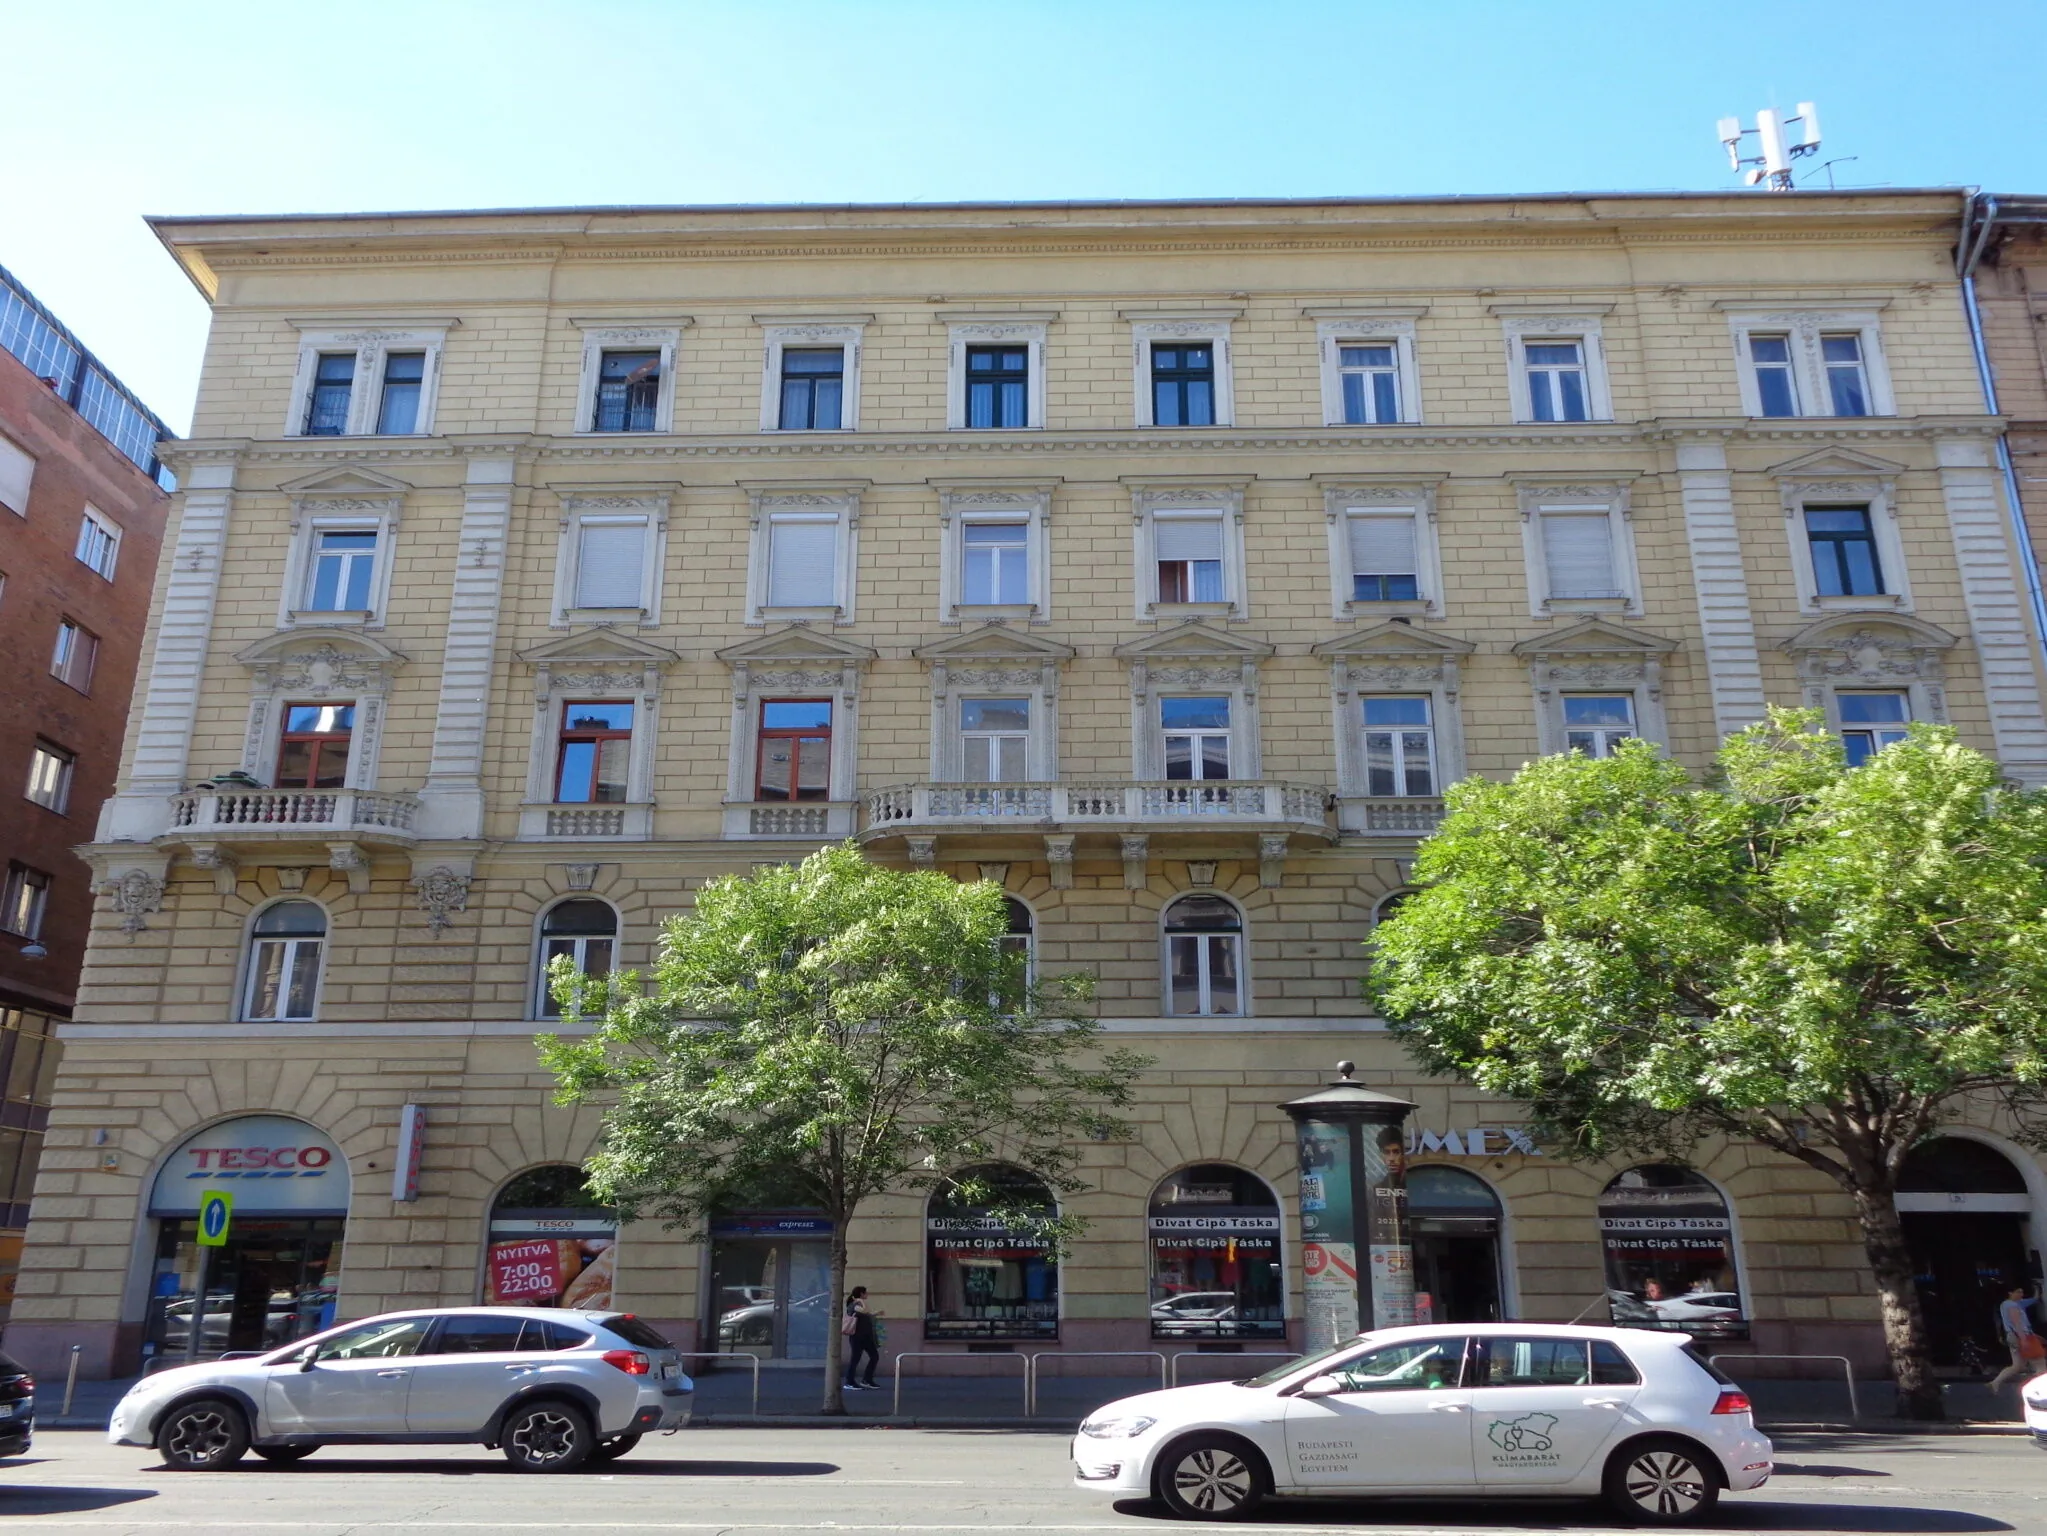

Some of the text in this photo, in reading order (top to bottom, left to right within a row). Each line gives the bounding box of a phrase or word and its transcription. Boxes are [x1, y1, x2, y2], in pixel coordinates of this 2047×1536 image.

[188, 1146, 331, 1169] TESCO
[535, 1220, 574, 1228] TESCO
[1155, 1218, 1192, 1228] Divat
[1231, 1218, 1273, 1228] Táska
[1604, 1219, 1642, 1228] Divat
[1681, 1218, 1724, 1228] Táska
[935, 1239, 970, 1248] Divat
[1008, 1238, 1049, 1248] Táska
[1157, 1239, 1193, 1248] Divat
[1231, 1238, 1272, 1248] Táska
[1607, 1239, 1645, 1248] Divat
[1681, 1238, 1724, 1248] Táska
[496, 1244, 552, 1261] NYITVA
[500, 1262, 540, 1280] 7:00
[500, 1275, 553, 1294] 22:00
[1298, 1441, 1353, 1449] BUDAPESTI
[1301, 1464, 1349, 1473] EGYETEM
